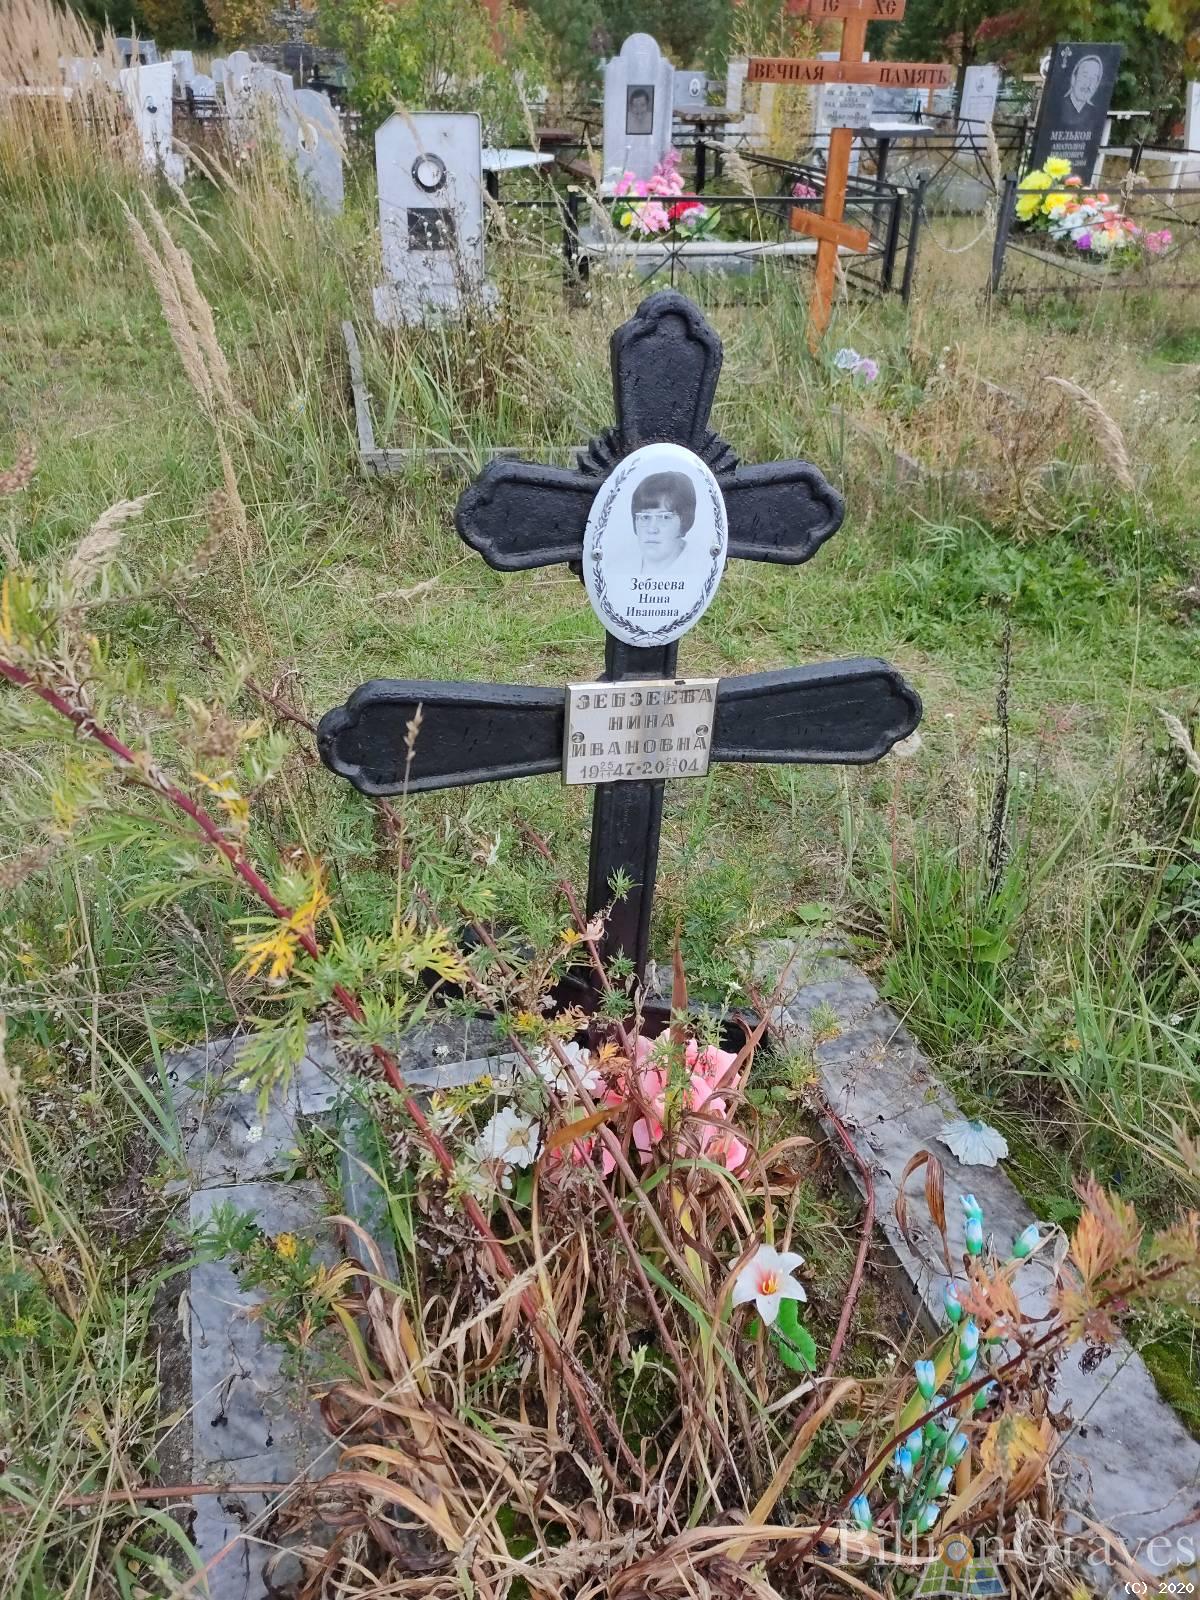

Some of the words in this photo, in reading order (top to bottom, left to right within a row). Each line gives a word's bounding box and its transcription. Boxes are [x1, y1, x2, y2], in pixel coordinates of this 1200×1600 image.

[754, 63, 825, 81] ВЕЧНАЯ
[880, 67, 948, 84] ПАМЯТЬ
[1050, 130, 1092, 141] МЕЛЬКОВ
[630, 577, 685, 591] Зебзеева
[639, 593, 671, 604] Нина
[626, 607, 680, 617] Ивановна
[576, 688, 713, 710] ЗЕБЗЕЕВА
[608, 713, 675, 731] НИНА
[570, 736, 708, 758] ИВАНОВНА
